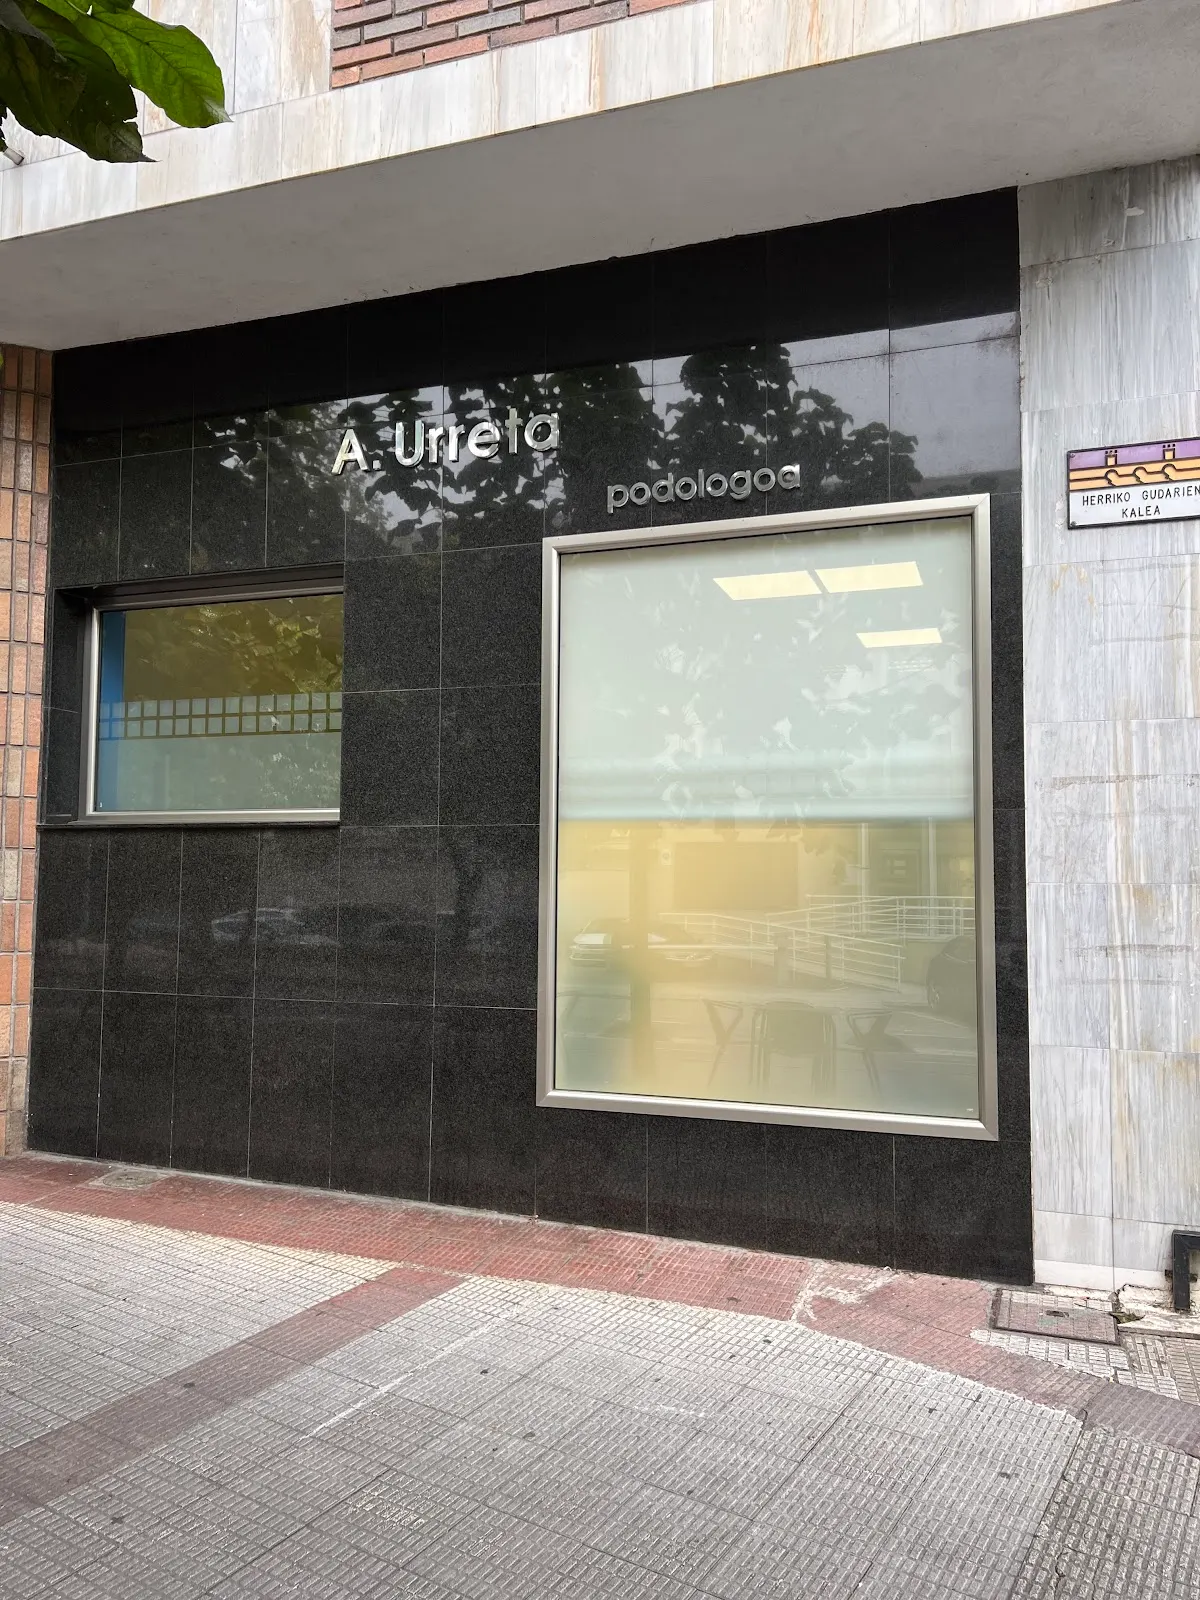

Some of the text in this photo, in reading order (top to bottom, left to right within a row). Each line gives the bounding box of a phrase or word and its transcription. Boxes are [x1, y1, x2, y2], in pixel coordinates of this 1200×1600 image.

[331, 407, 561, 475] A. Urreta
[606, 463, 801, 514] podologoa
[1082, 485, 1200, 506] HERRIKO GUDARIEN
[1121, 505, 1161, 519] KALEA
